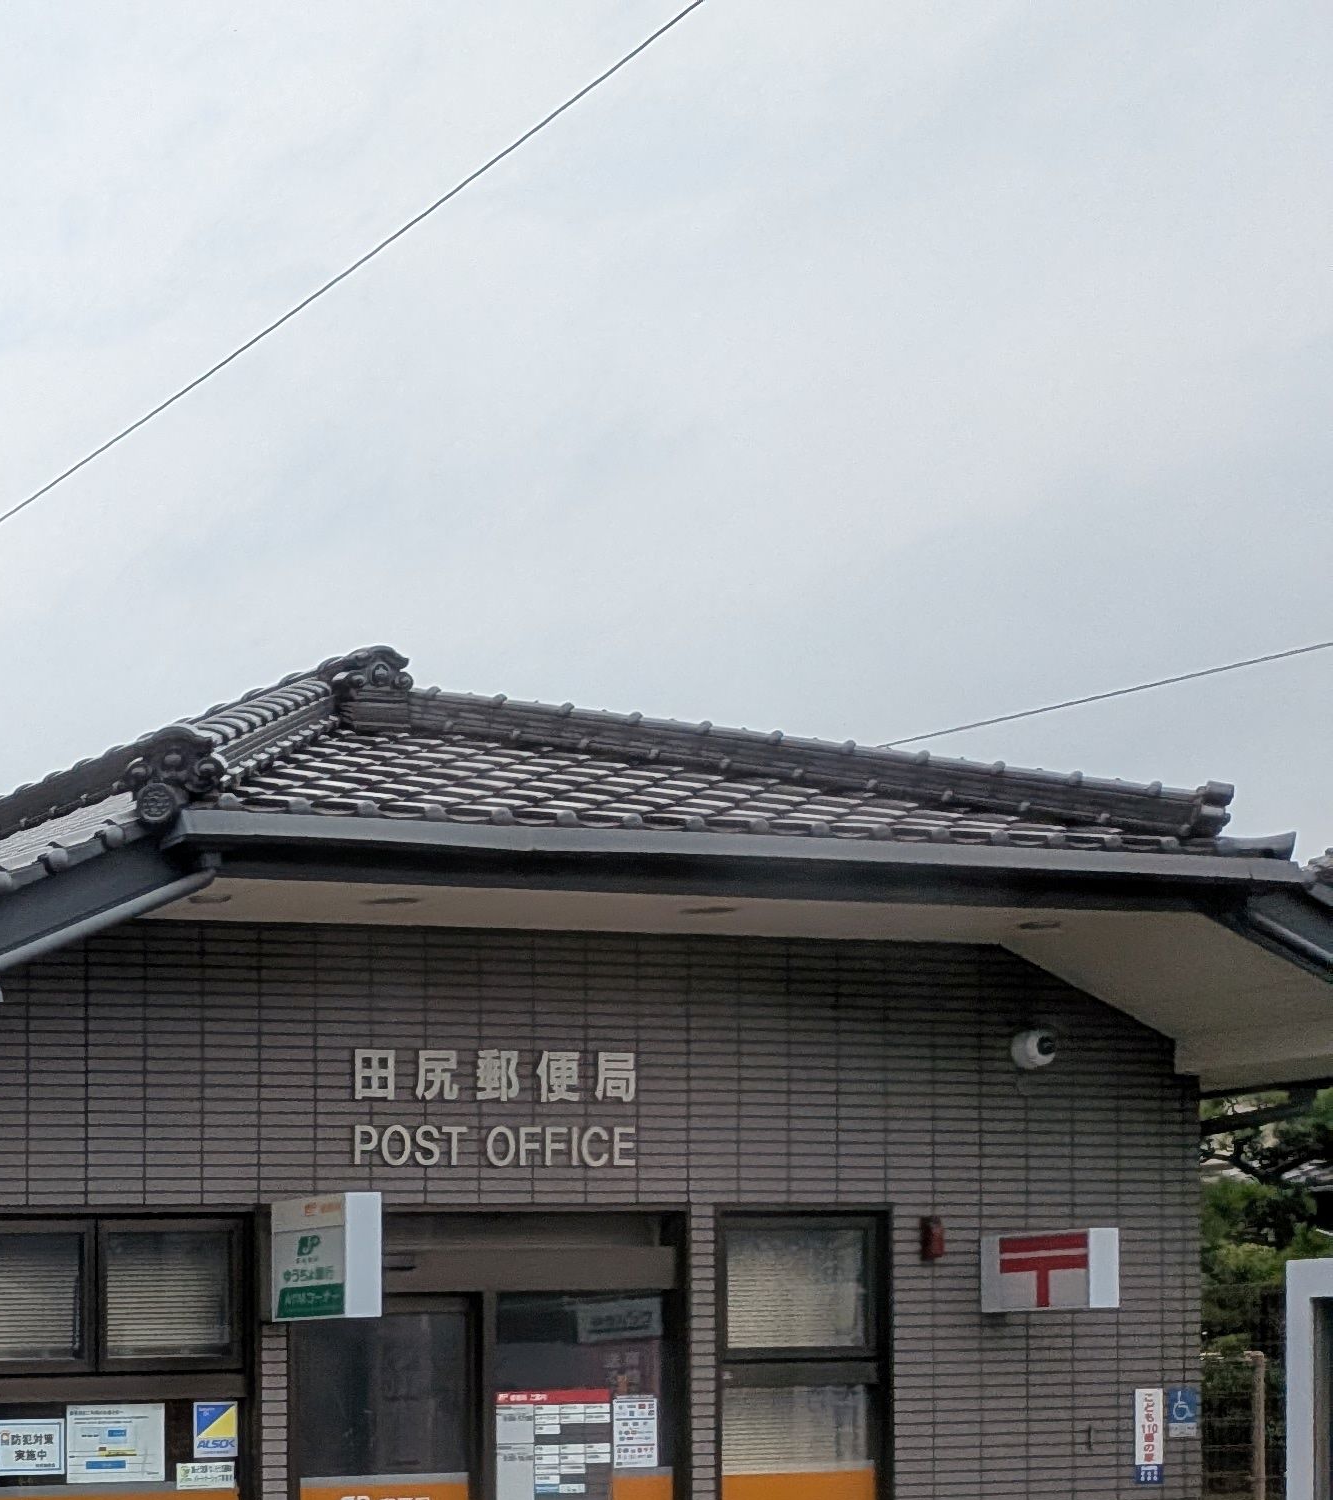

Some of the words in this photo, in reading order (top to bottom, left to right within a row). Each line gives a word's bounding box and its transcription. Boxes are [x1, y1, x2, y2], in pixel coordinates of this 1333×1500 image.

[353, 1048, 637, 1102] 田尻郵便局
[354, 1125, 469, 1166] POST
[486, 1125, 637, 1167] OFFICE
[10, 1433, 54, 1446] 防犯対策
[196, 1439, 236, 1449] ALSOK
[14, 1449, 48, 1462] 実施中
